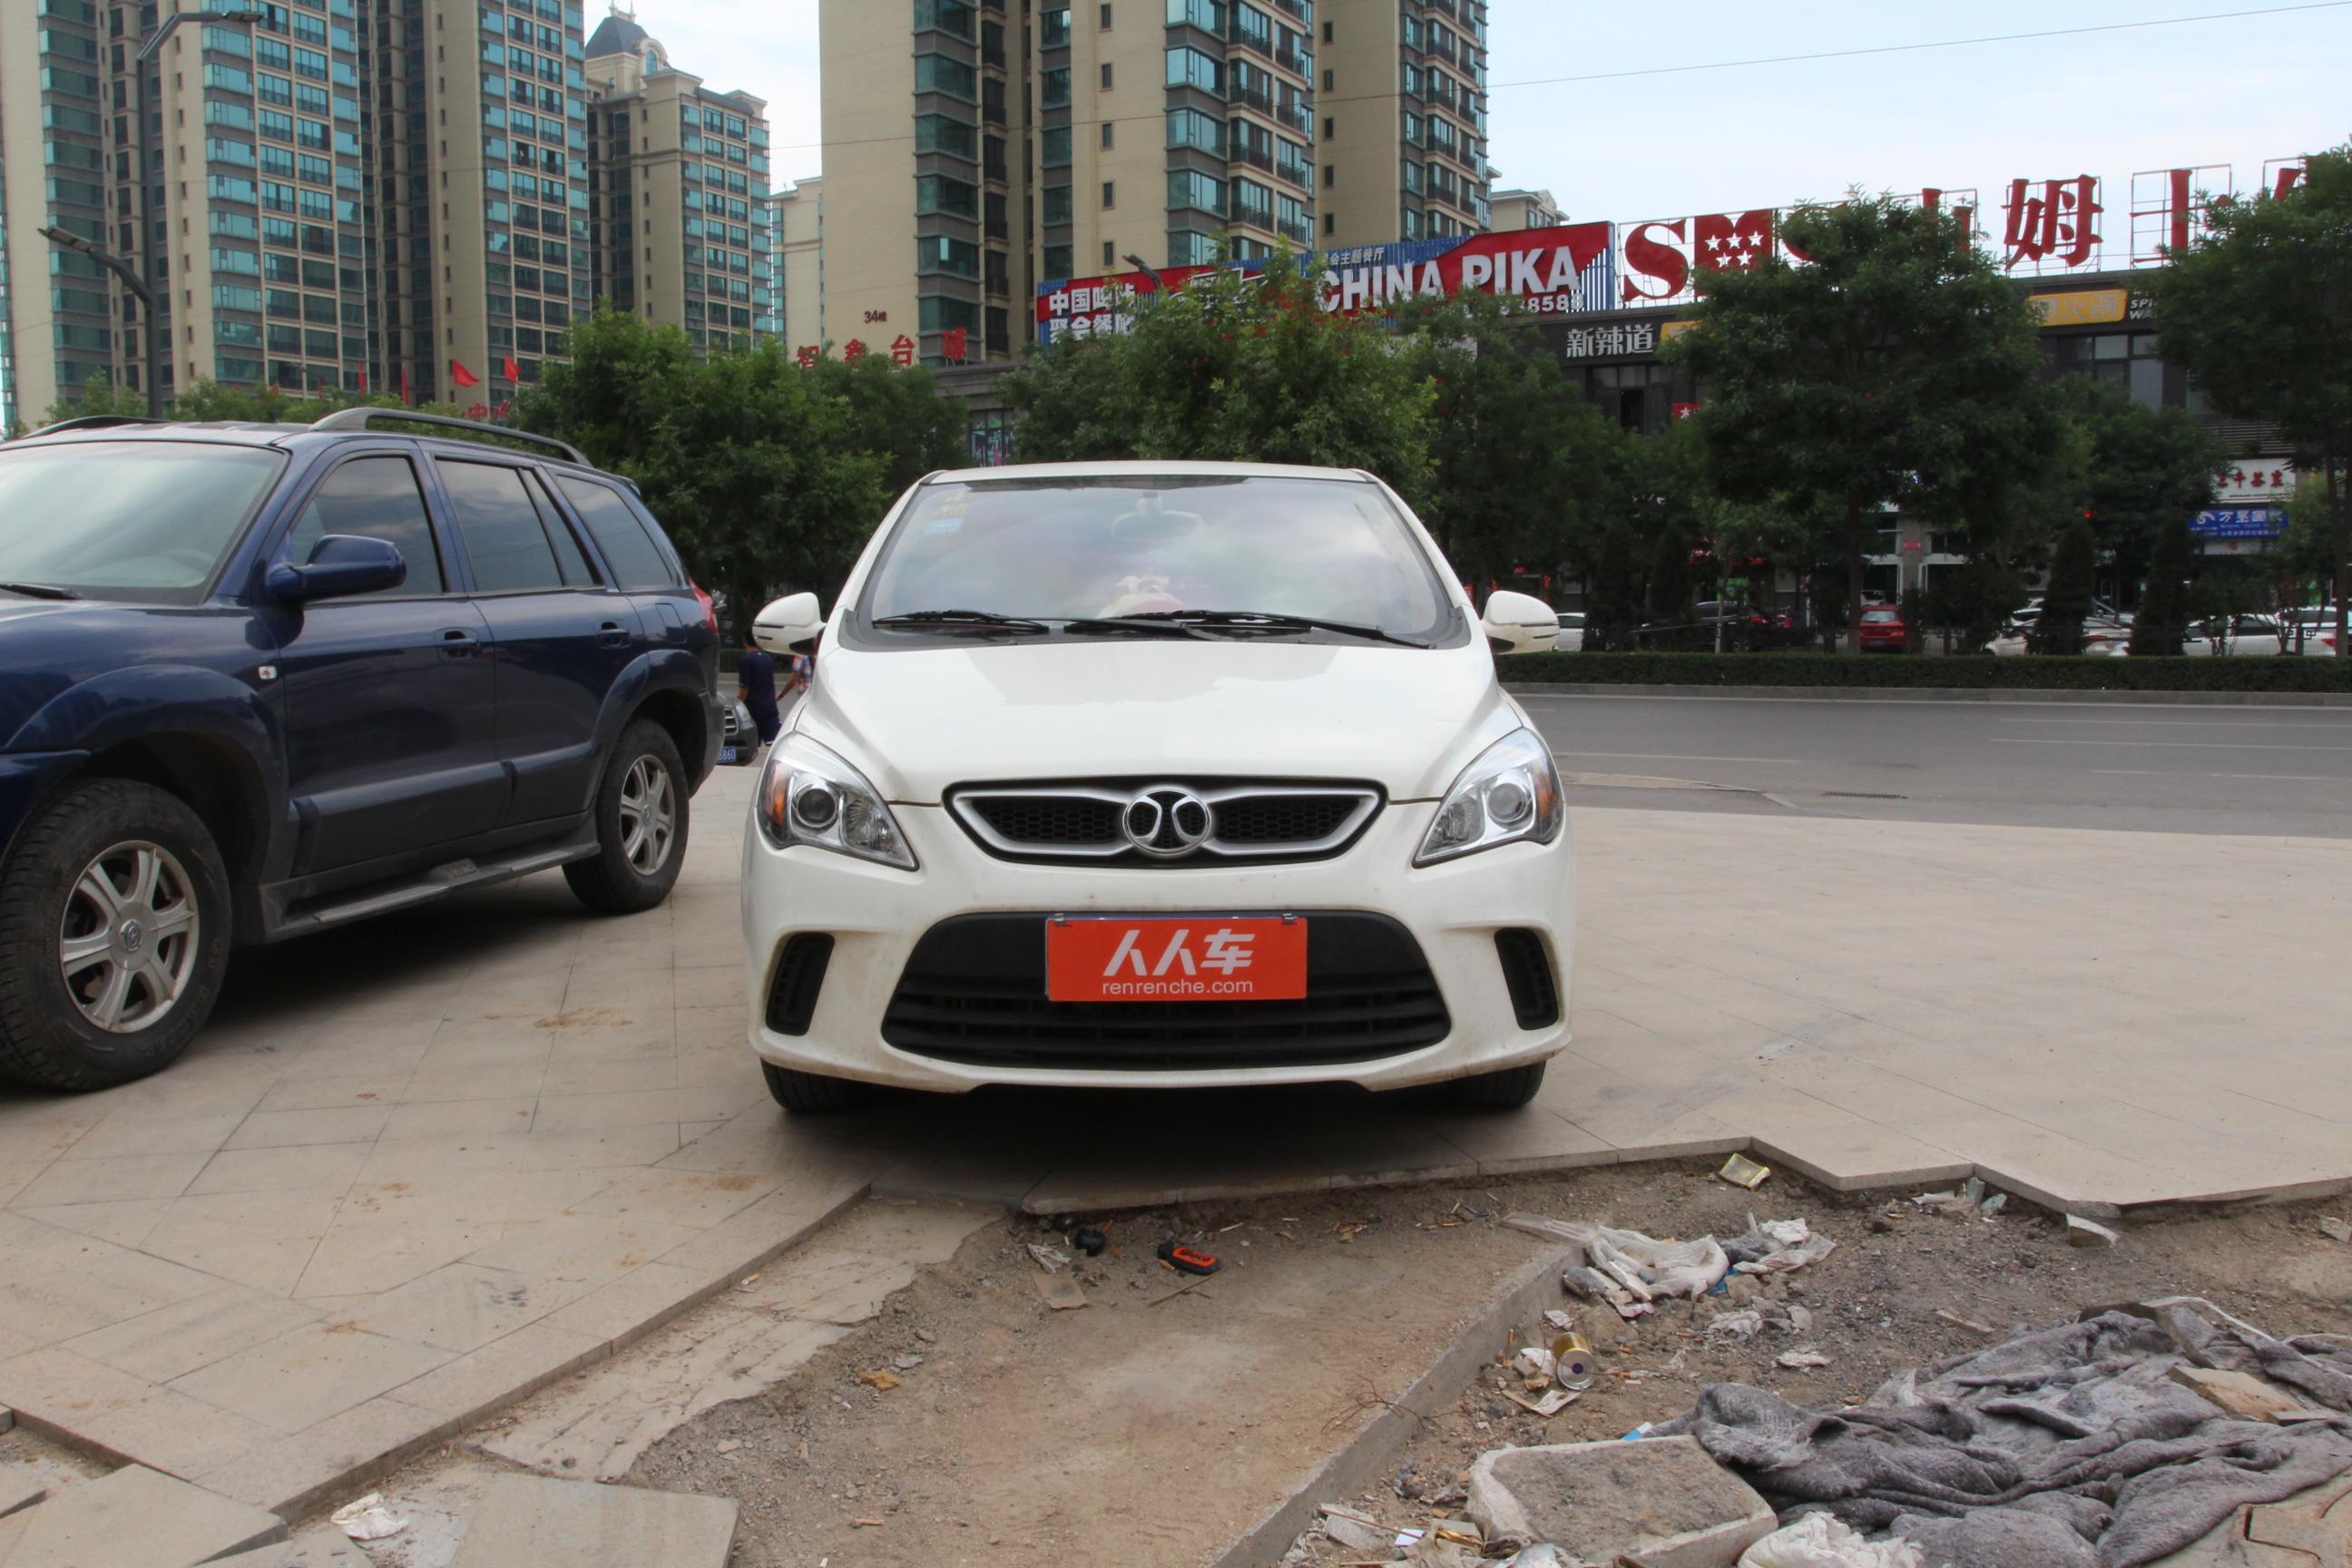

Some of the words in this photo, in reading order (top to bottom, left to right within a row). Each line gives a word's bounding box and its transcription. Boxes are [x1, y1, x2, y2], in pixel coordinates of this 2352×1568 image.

[1315, 260, 1445, 312] CHINA
[1462, 245, 1582, 296] PIKA
[1566, 323, 1654, 358] 新辣道
[456, 399, 512, 421] 中心
[1102, 928, 1256, 976] 人人车
[1102, 978, 1253, 995] renrenche.com
